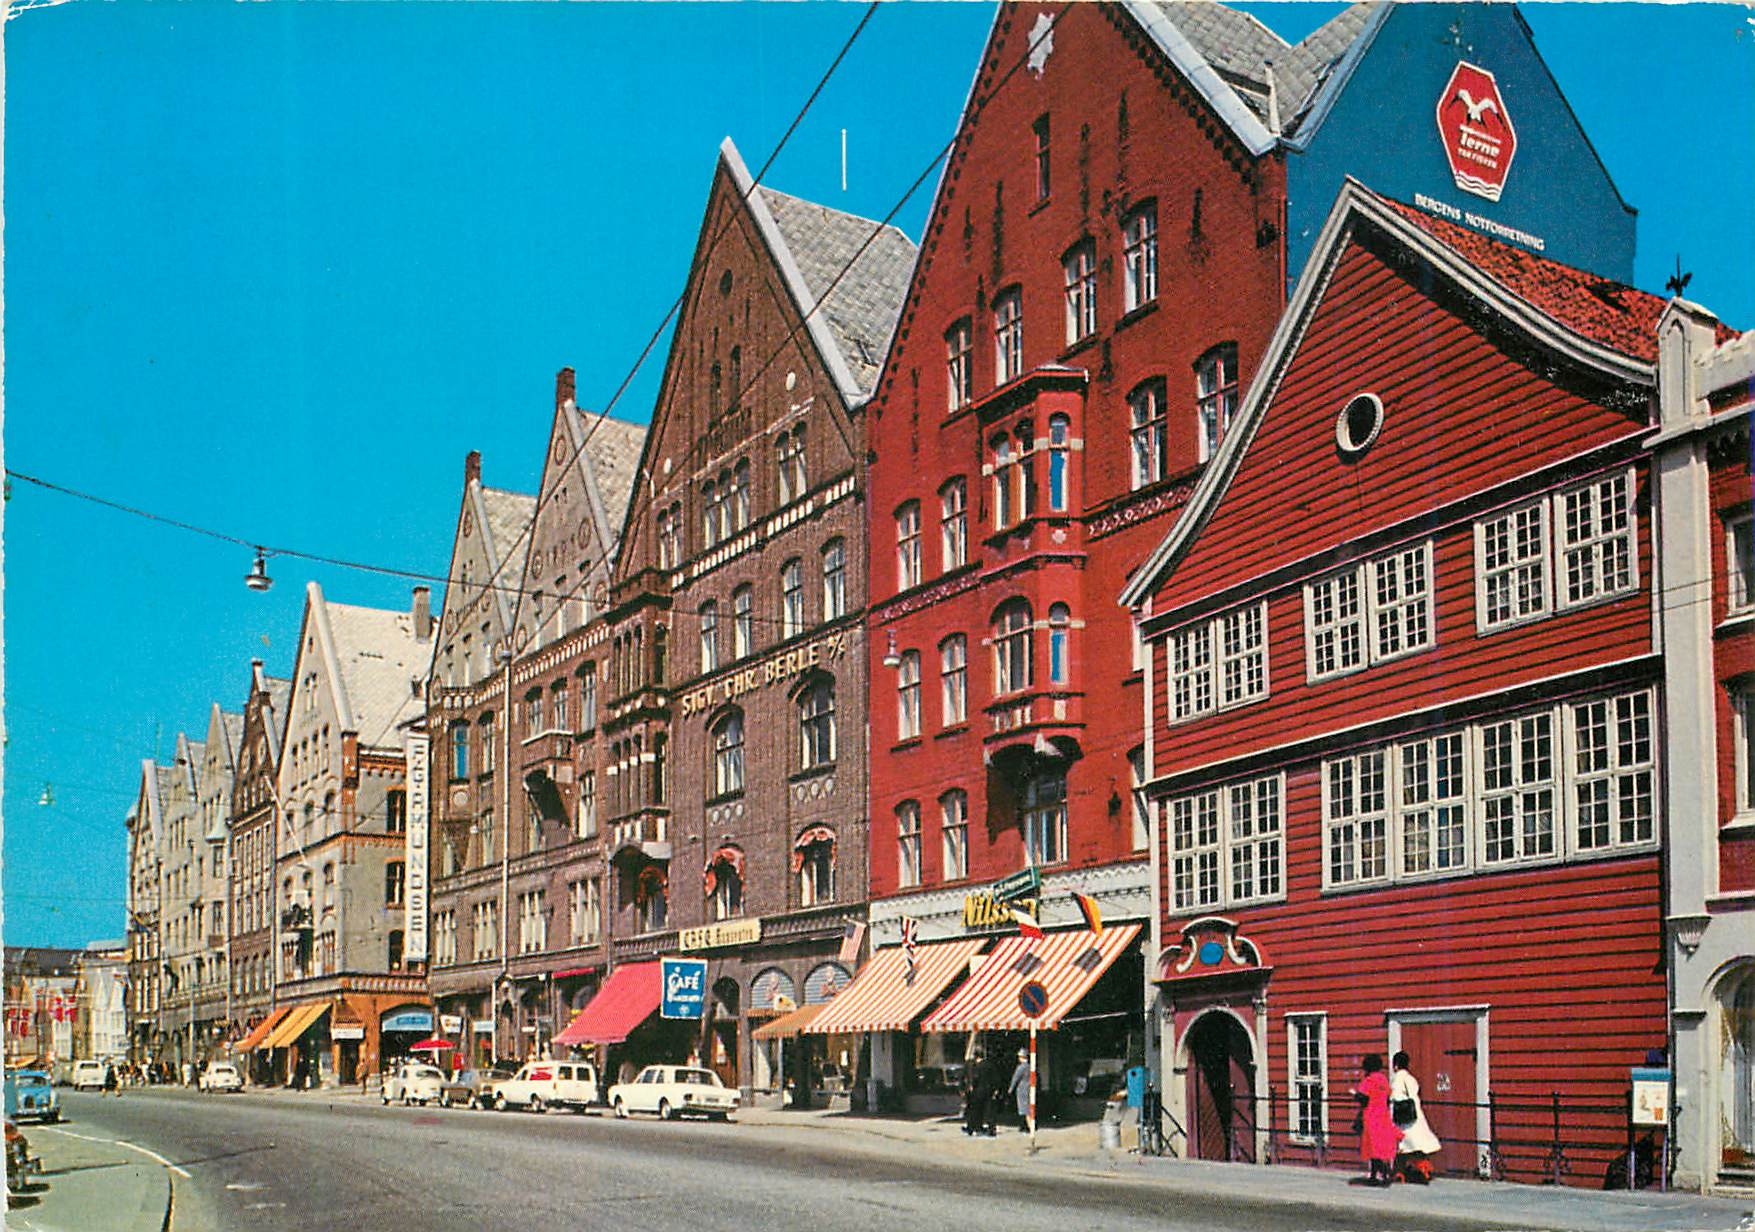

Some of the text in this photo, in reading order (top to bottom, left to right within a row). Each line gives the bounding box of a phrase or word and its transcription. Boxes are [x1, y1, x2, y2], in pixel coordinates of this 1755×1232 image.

[1414, 194, 1461, 220] BERGENS
[765, 643, 820, 682] BERLE
[667, 970, 701, 996] CAFÉ
